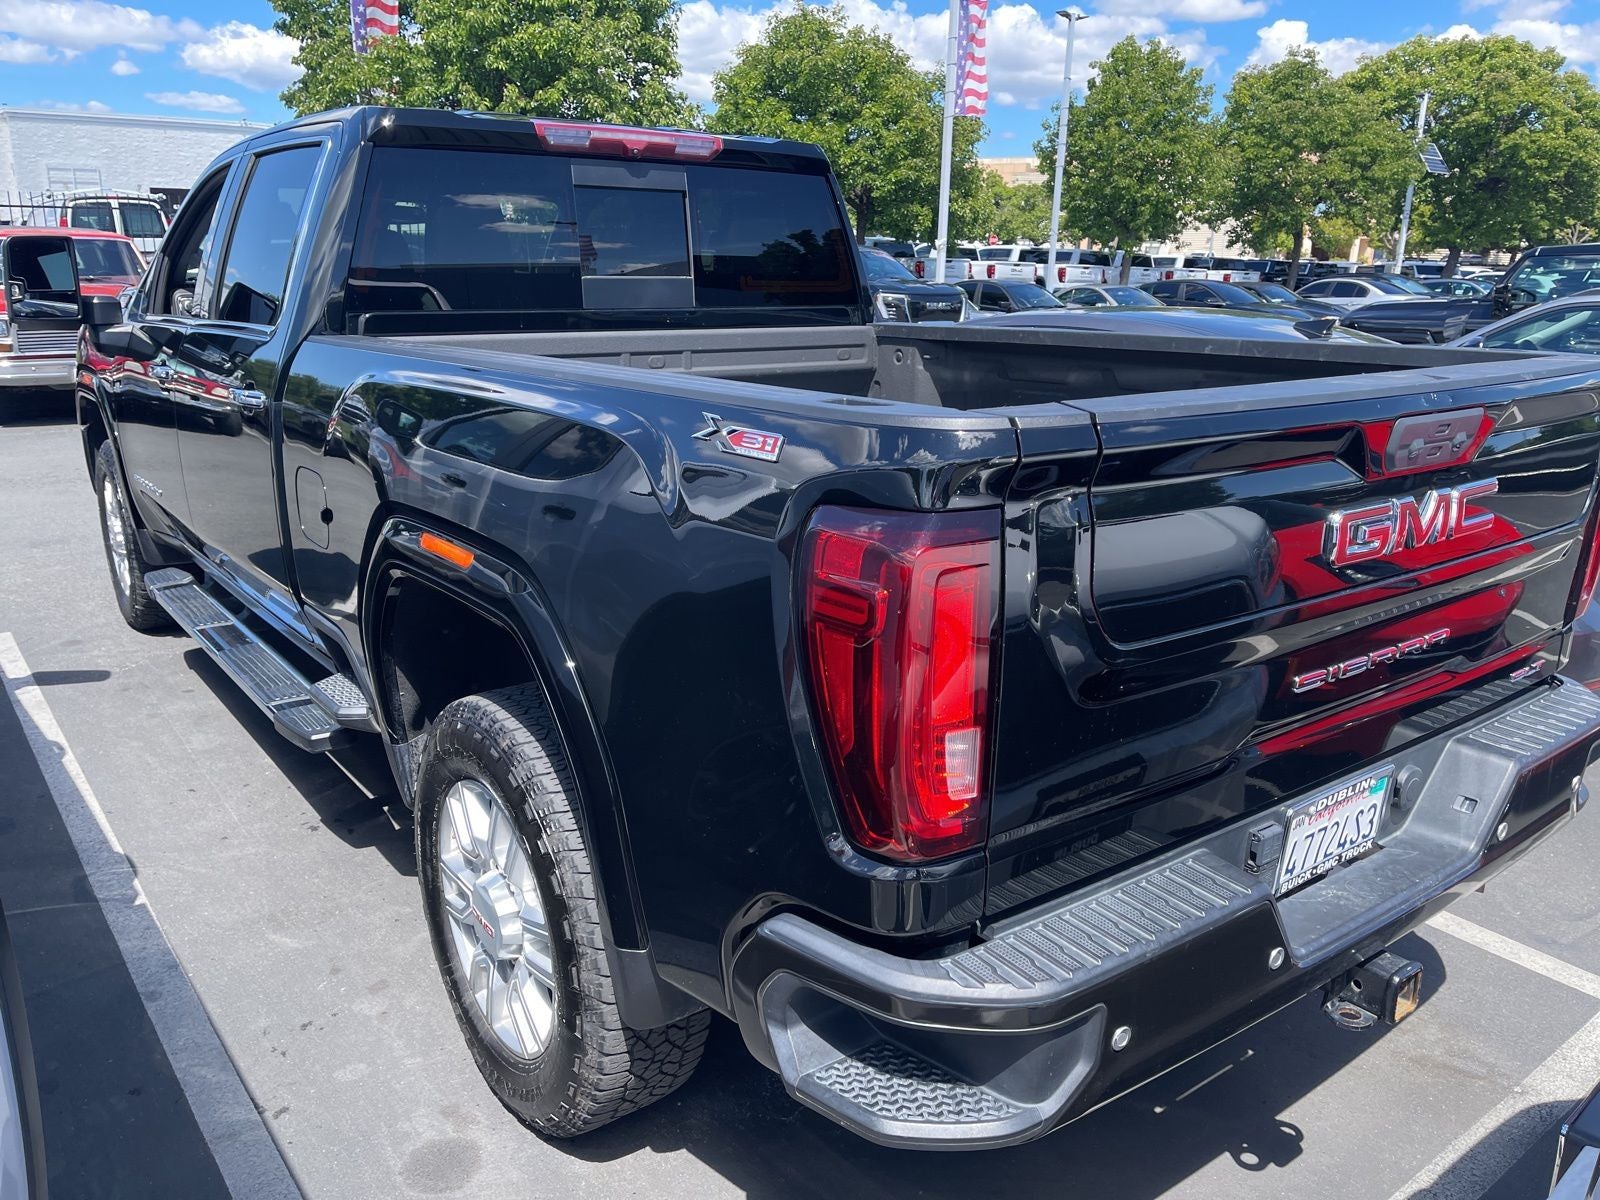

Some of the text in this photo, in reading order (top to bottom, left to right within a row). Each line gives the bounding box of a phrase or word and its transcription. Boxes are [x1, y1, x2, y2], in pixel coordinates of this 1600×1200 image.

[1321, 477, 1499, 568] GMC
[1292, 627, 1451, 693] SIERRA
[1315, 777, 1372, 812] DUBLIN
[1286, 802, 1377, 876] 47724S3
[1280, 867, 1314, 894] BUICK
[1316, 857, 1339, 874] GMC
